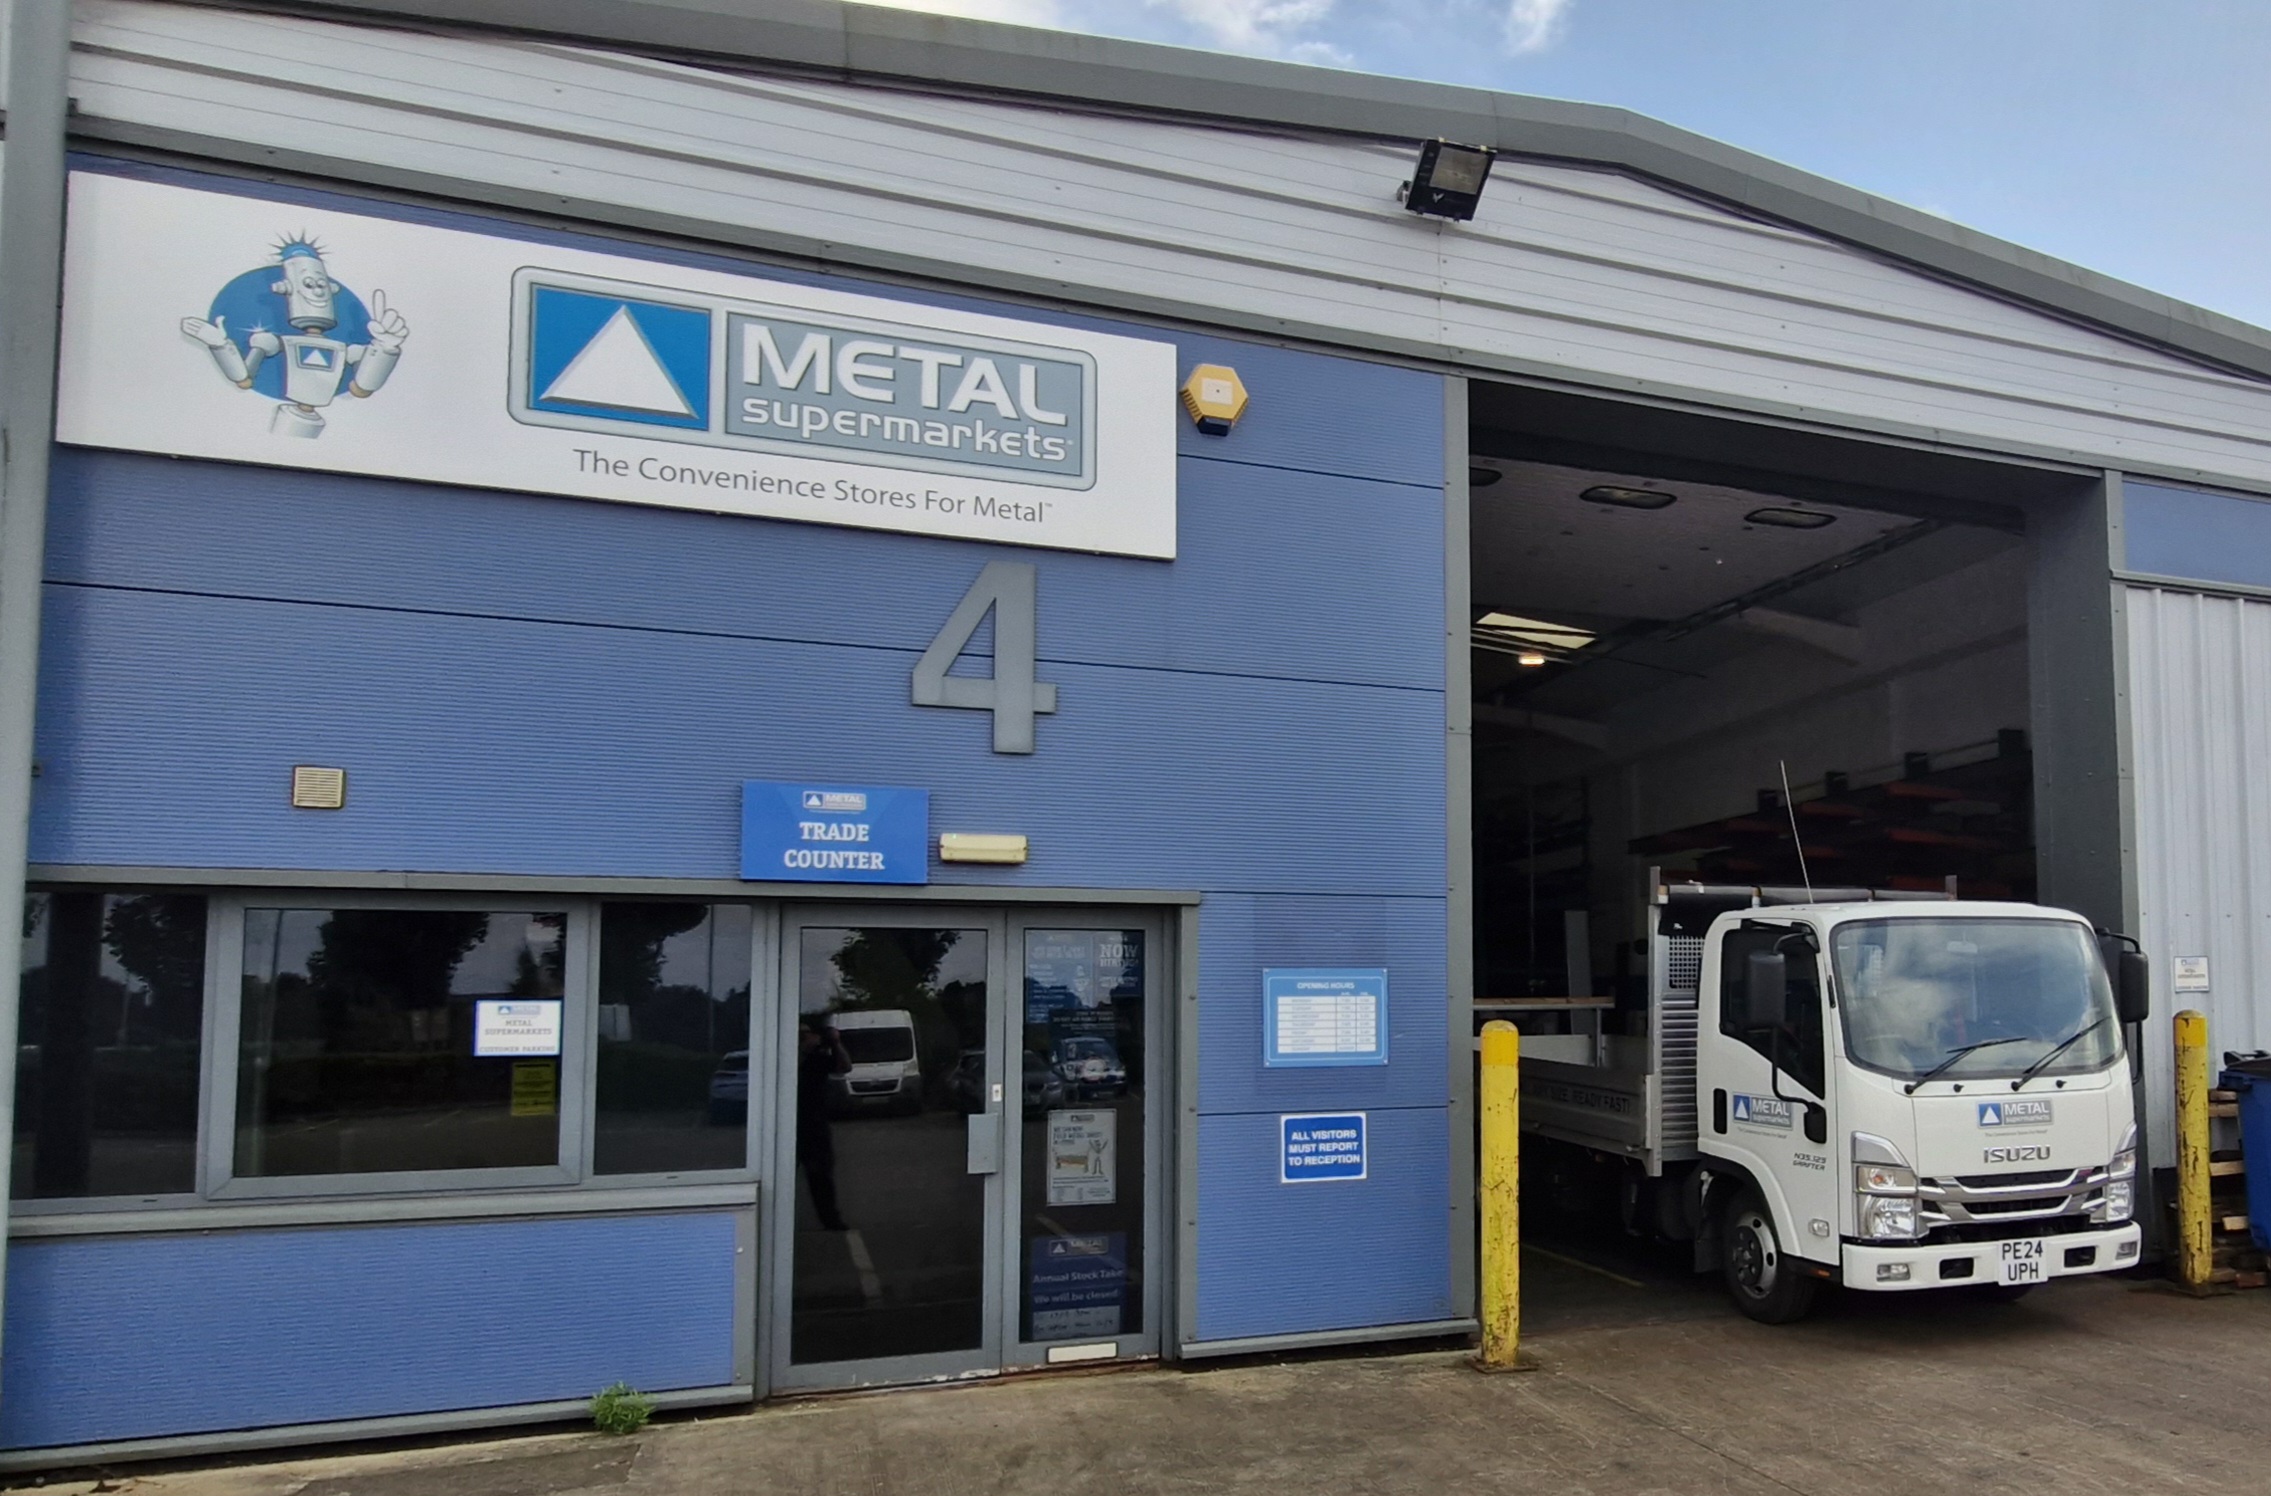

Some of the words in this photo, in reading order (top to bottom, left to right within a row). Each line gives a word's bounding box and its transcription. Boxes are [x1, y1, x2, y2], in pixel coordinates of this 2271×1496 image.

[742, 323, 1067, 426] METAL
[742, 397, 1068, 461] supermarkets
[573, 448, 630, 477] The
[638, 456, 826, 500] Convenience
[834, 478, 917, 510] Stores
[925, 488, 966, 514] For
[911, 560, 1057, 755] 4
[799, 821, 870, 842] TRADE
[784, 849, 886, 870] COUNTER
[1099, 943, 1139, 958] NOW
[1296, 981, 1330, 990] OPENING
[1330, 981, 1355, 990] HOURS
[505, 1019, 533, 1027] METAL
[484, 1028, 553, 1036] SUPERMARKETS
[1751, 1098, 1790, 1116] METAL
[2004, 1101, 2050, 1115] METAL
[1291, 1131, 1310, 1141] ALL
[1311, 1129, 1358, 1140] VISITORS
[1288, 1142, 1317, 1154] MUST
[1318, 1141, 1359, 1152] REPORT
[1983, 1145, 2051, 1164] ISUZU
[1288, 1156, 1302, 1167] TO
[1304, 1154, 1361, 1166] RECEPTION
[2001, 1240, 2044, 1261] PE24
[1033, 1272, 1070, 1284] Annual
[1071, 1271, 1098, 1281] Stock
[1099, 1268, 1124, 1279] Take
[2007, 1262, 2039, 1282] UPH
[1034, 1295, 1050, 1305] We
[1051, 1291, 1070, 1302] will
[1072, 1291, 1085, 1301] be
[1086, 1288, 1119, 1301] closed
